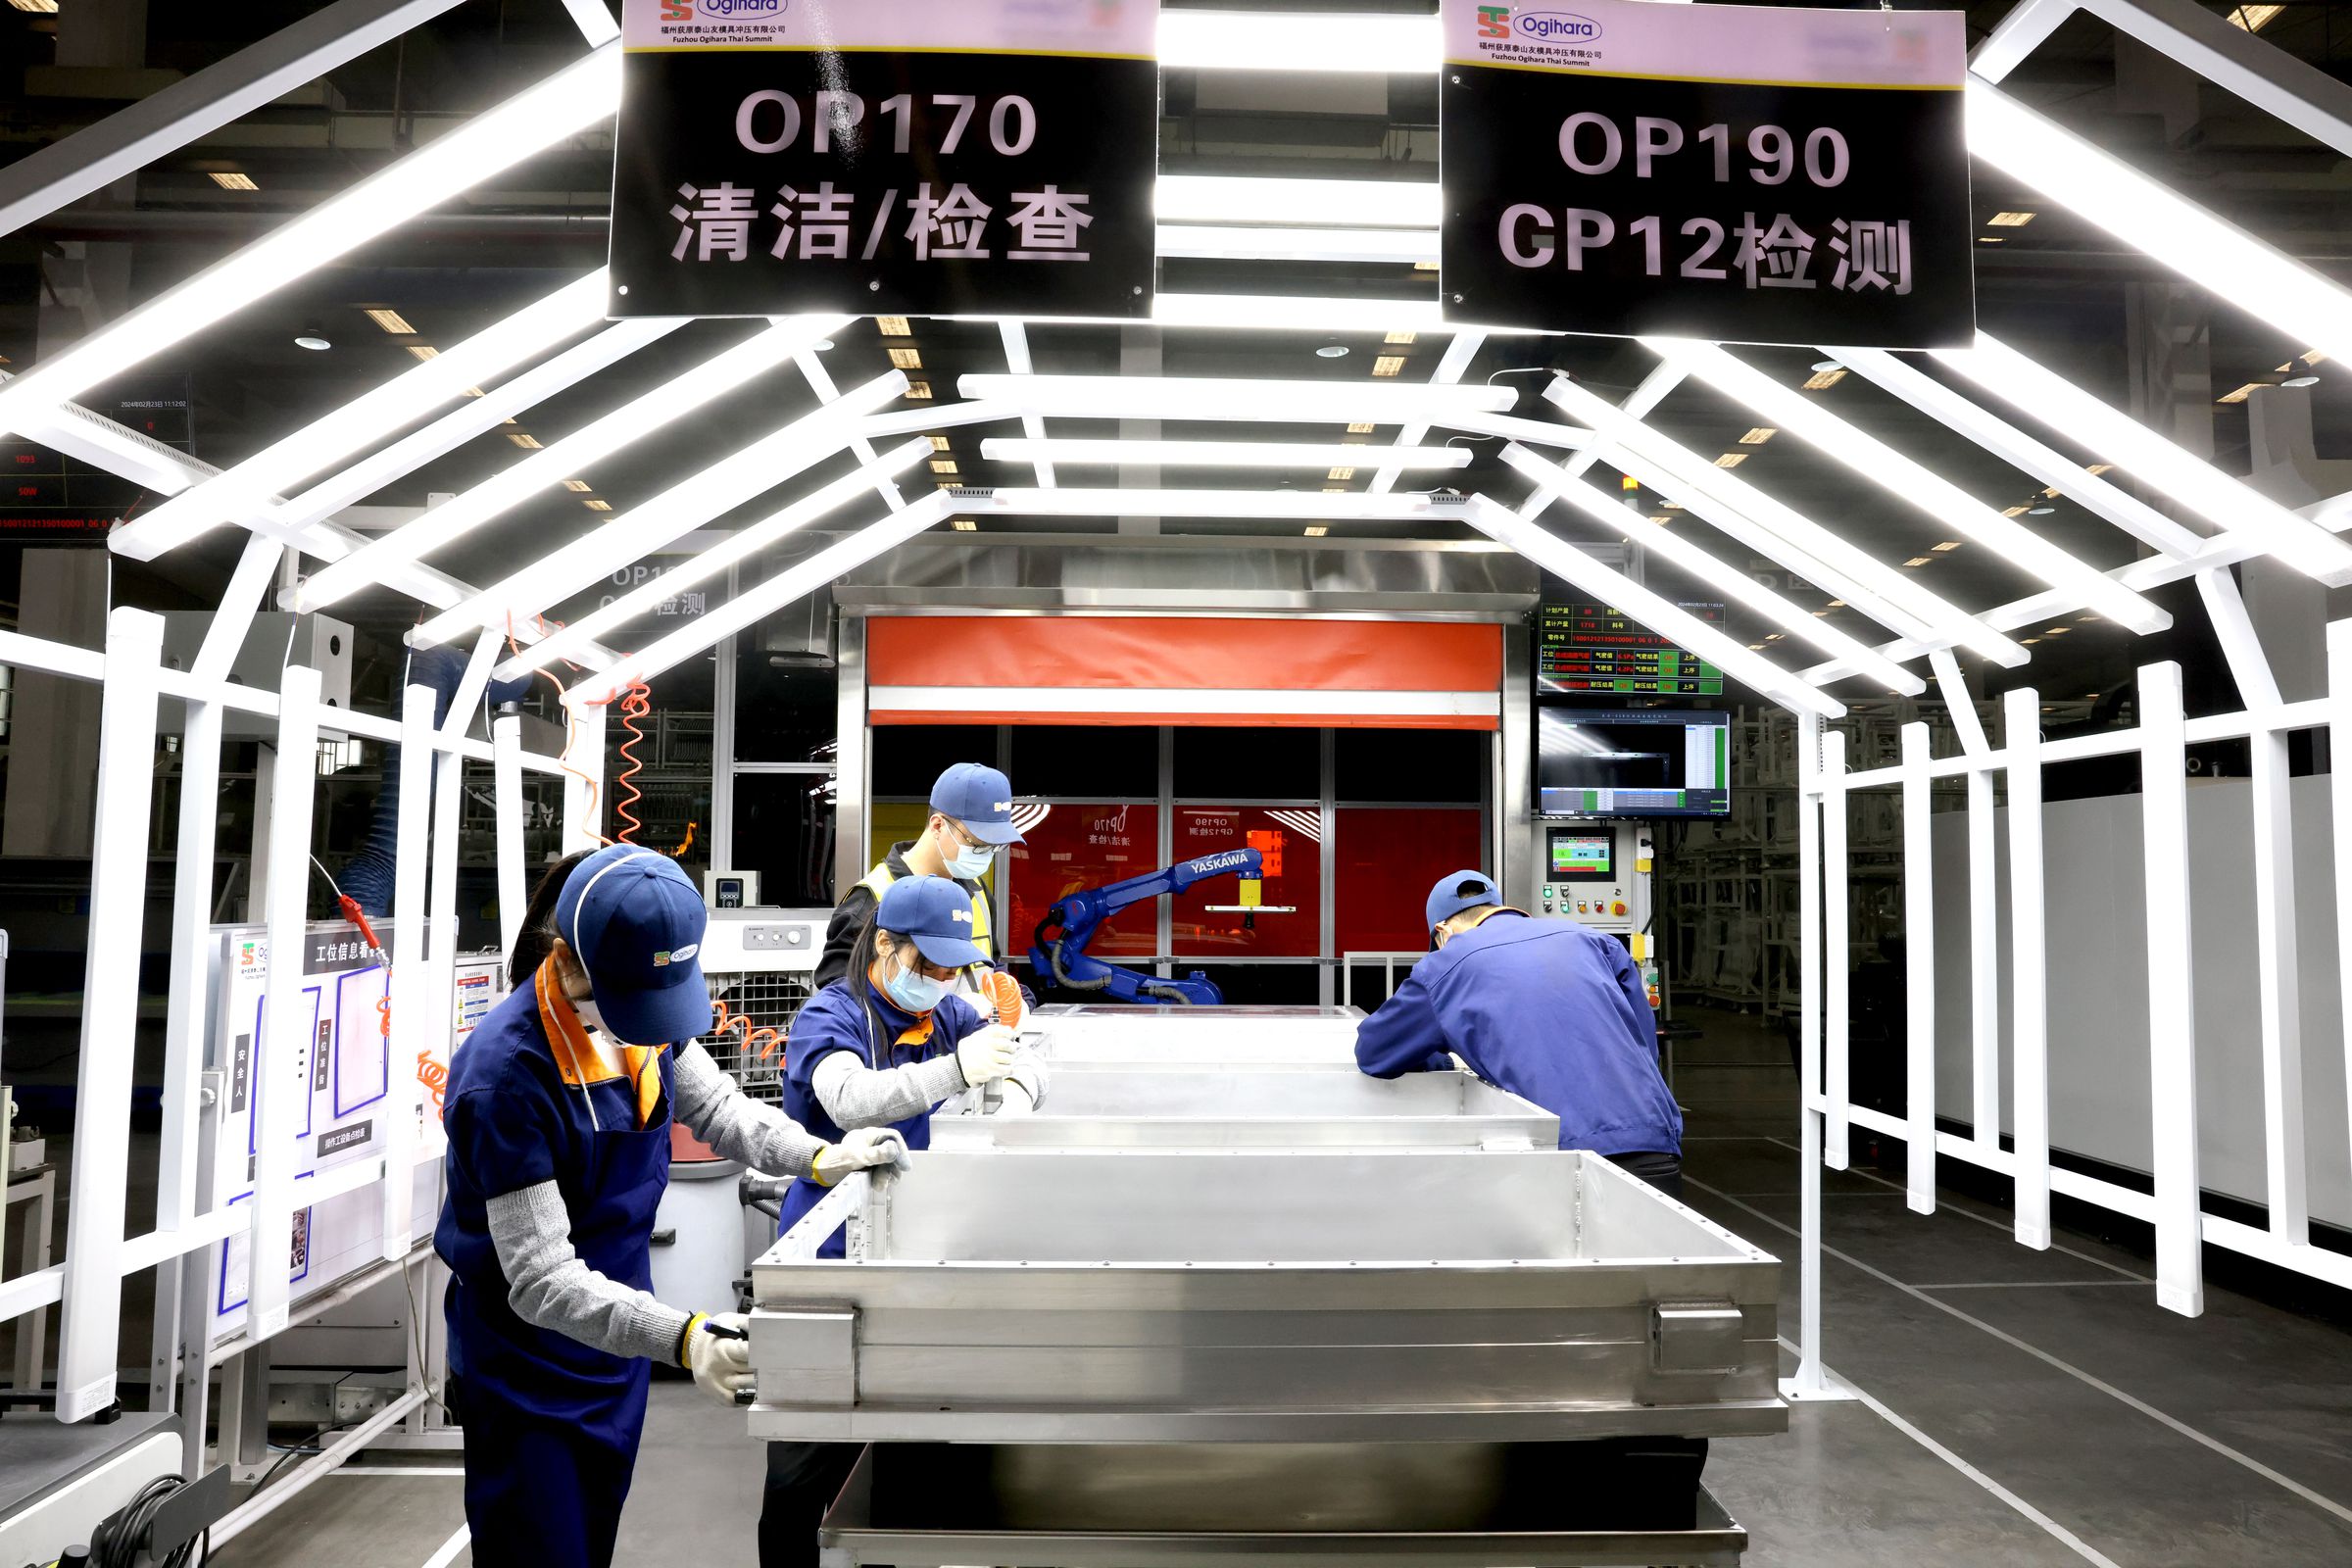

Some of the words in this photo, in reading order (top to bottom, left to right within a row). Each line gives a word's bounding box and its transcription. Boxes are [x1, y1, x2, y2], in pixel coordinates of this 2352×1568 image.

[1522, 17, 1592, 37] Ogihara
[1492, 53, 1517, 62] Fuzhou
[1517, 55, 1545, 64] Ogihara
[735, 89, 1037, 156] OP170
[1558, 111, 1850, 188] OP190
[668, 181, 1095, 262] 清洁/检查
[1497, 202, 1912, 295] GP12检测
[1191, 852, 1249, 874] YASKAWA
[235, 1049, 246, 1098] 安全人
